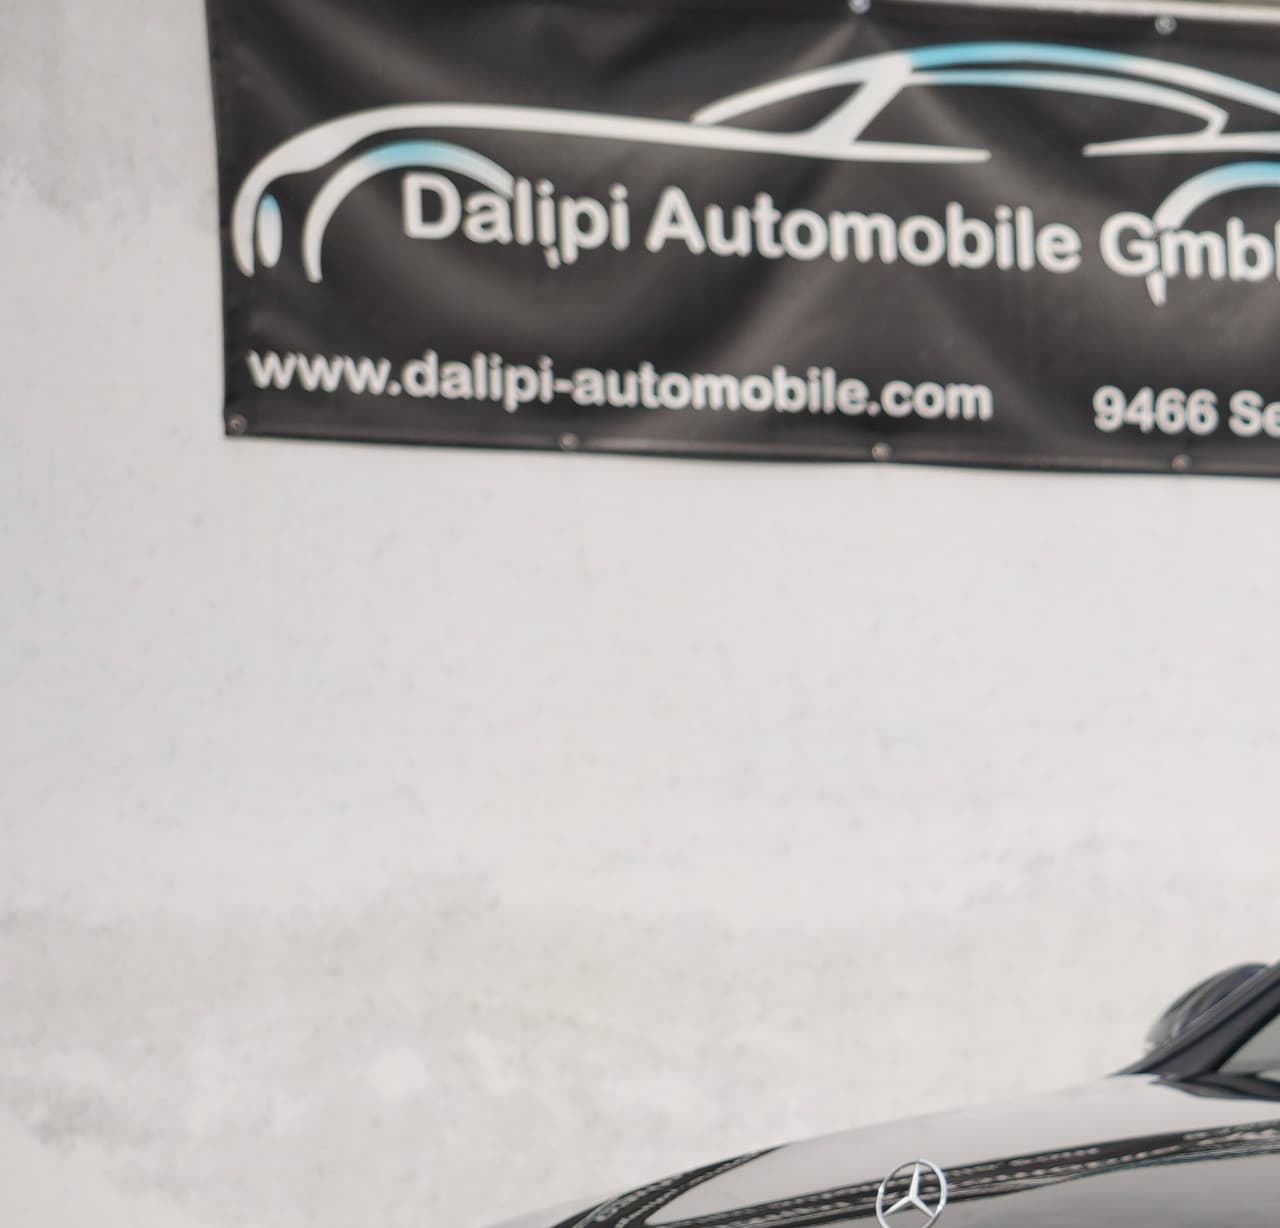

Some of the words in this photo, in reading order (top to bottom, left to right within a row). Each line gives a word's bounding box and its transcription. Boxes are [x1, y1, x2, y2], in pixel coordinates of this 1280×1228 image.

[401, 170, 631, 266] Dalipi
[644, 184, 1083, 274] Automobile
[246, 348, 995, 421] www.dalipi-automobile.com
[1091, 385, 1220, 436] 9466
